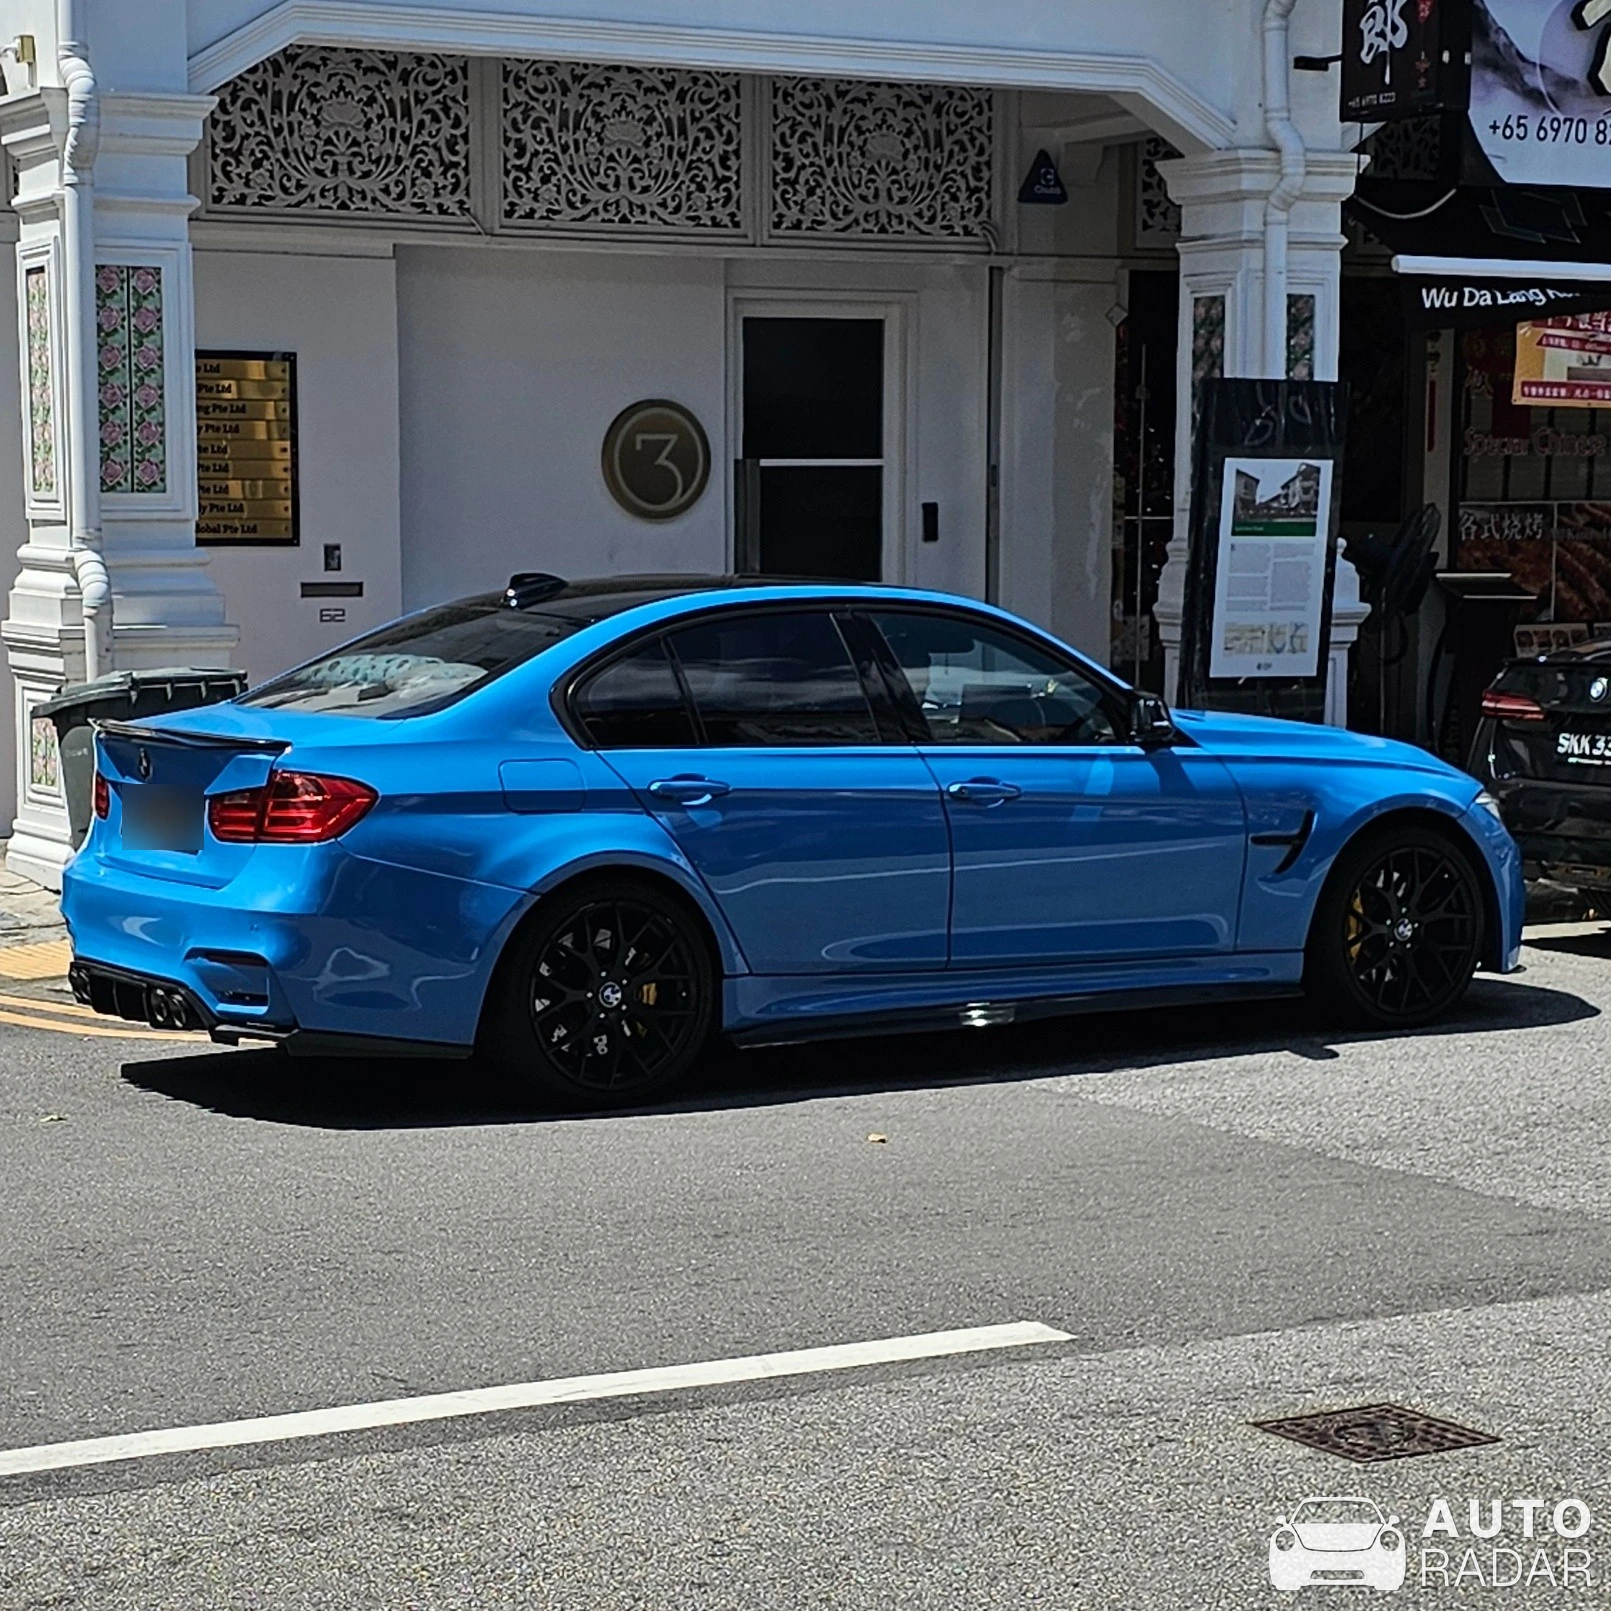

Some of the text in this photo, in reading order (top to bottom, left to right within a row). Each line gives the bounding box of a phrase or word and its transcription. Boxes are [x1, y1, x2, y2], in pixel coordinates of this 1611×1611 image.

[1489, 114, 1529, 141] +65
[1536, 116, 1588, 144] 6970
[1421, 287, 1458, 309] Wu
[1463, 287, 1493, 307] Da
[1493, 287, 1547, 306] Lang
[203, 363, 221, 374] Ltd
[215, 383, 232, 394] Ltd
[212, 403, 228, 414] Pte
[229, 403, 247, 414] Ltd
[204, 423, 221, 434] Pte
[223, 423, 240, 434] Ltd
[210, 444, 228, 454] Ltd
[212, 463, 230, 473] Ltd
[634, 432, 684, 511] 3
[212, 484, 230, 494] Ltd
[208, 503, 225, 513] Pte
[227, 503, 244, 513] Ltd
[222, 524, 240, 534] Pte
[240, 524, 258, 534] Ltd
[1459, 512, 1544, 541] 各式烧烤
[1556, 732, 1592, 756] SKK
